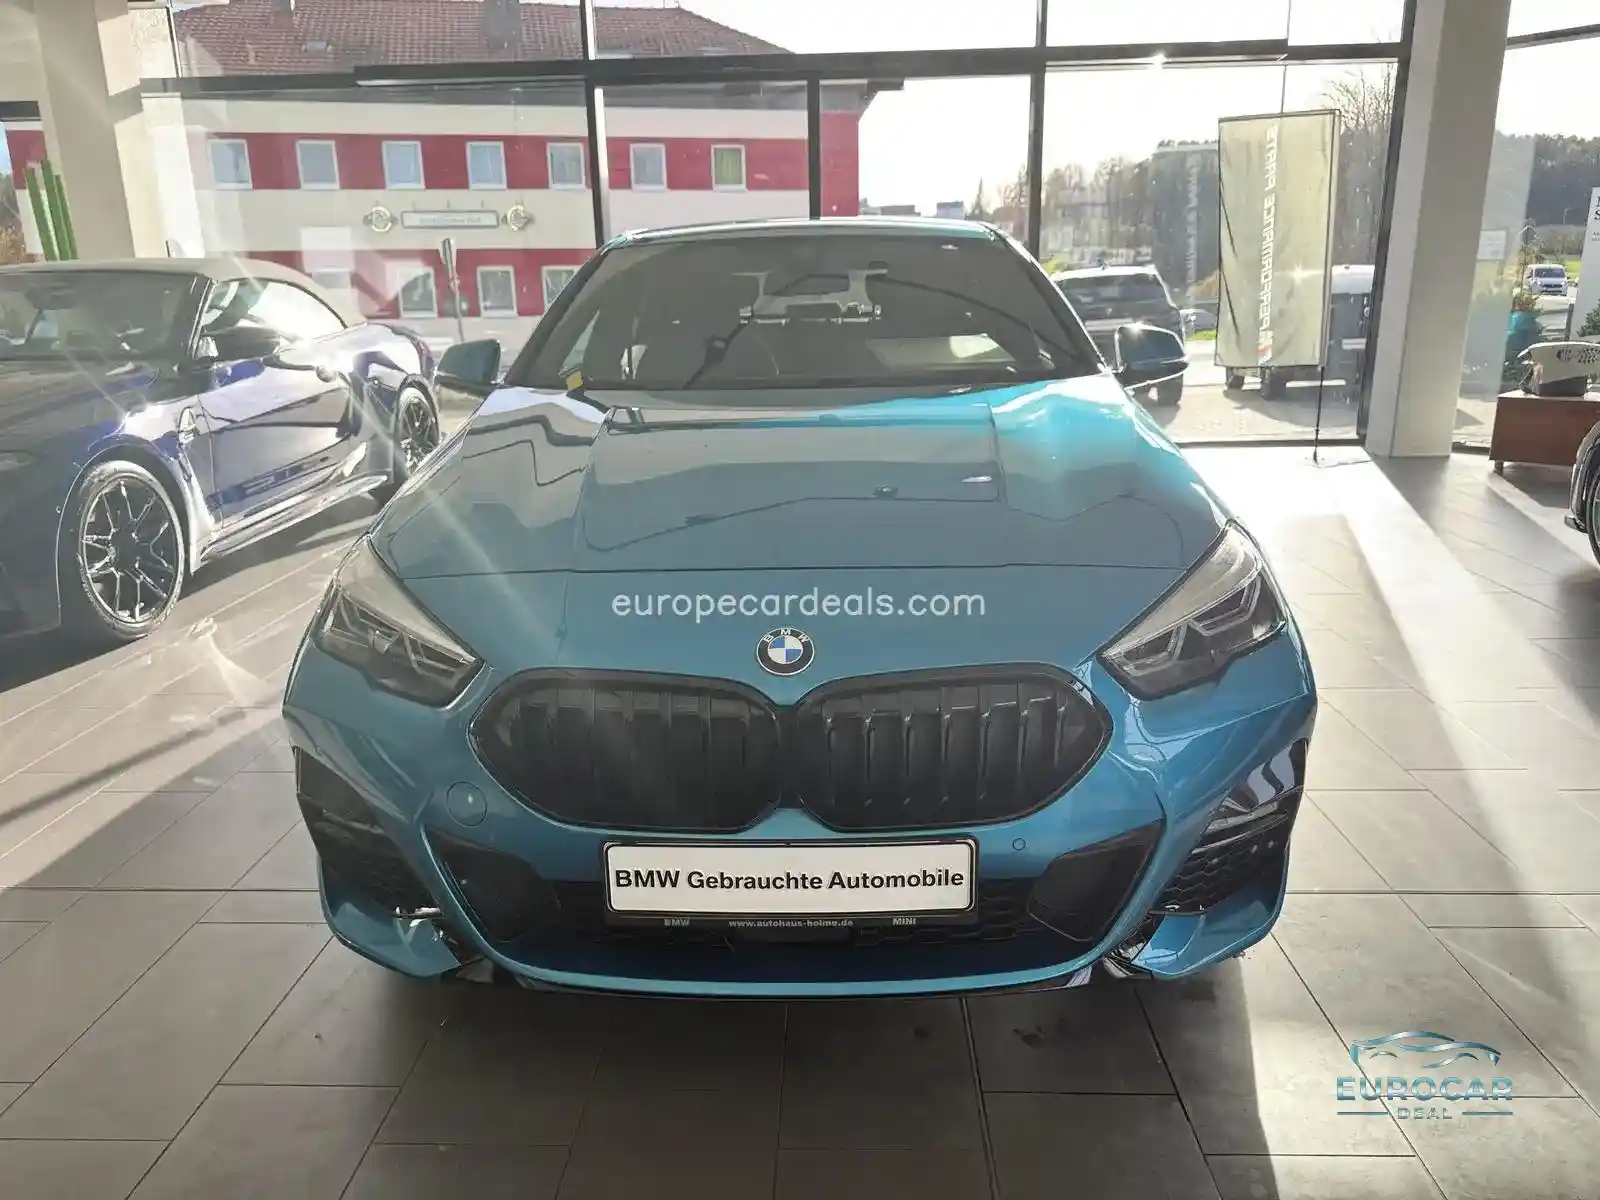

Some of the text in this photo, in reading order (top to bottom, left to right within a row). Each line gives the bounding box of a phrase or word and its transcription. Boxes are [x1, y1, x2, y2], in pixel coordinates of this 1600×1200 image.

[763, 629, 810, 643] BMW
[615, 869, 964, 890] BMW Gebrauchte Automobile
[664, 918, 690, 927] BMW
[892, 917, 916, 926] MINI
